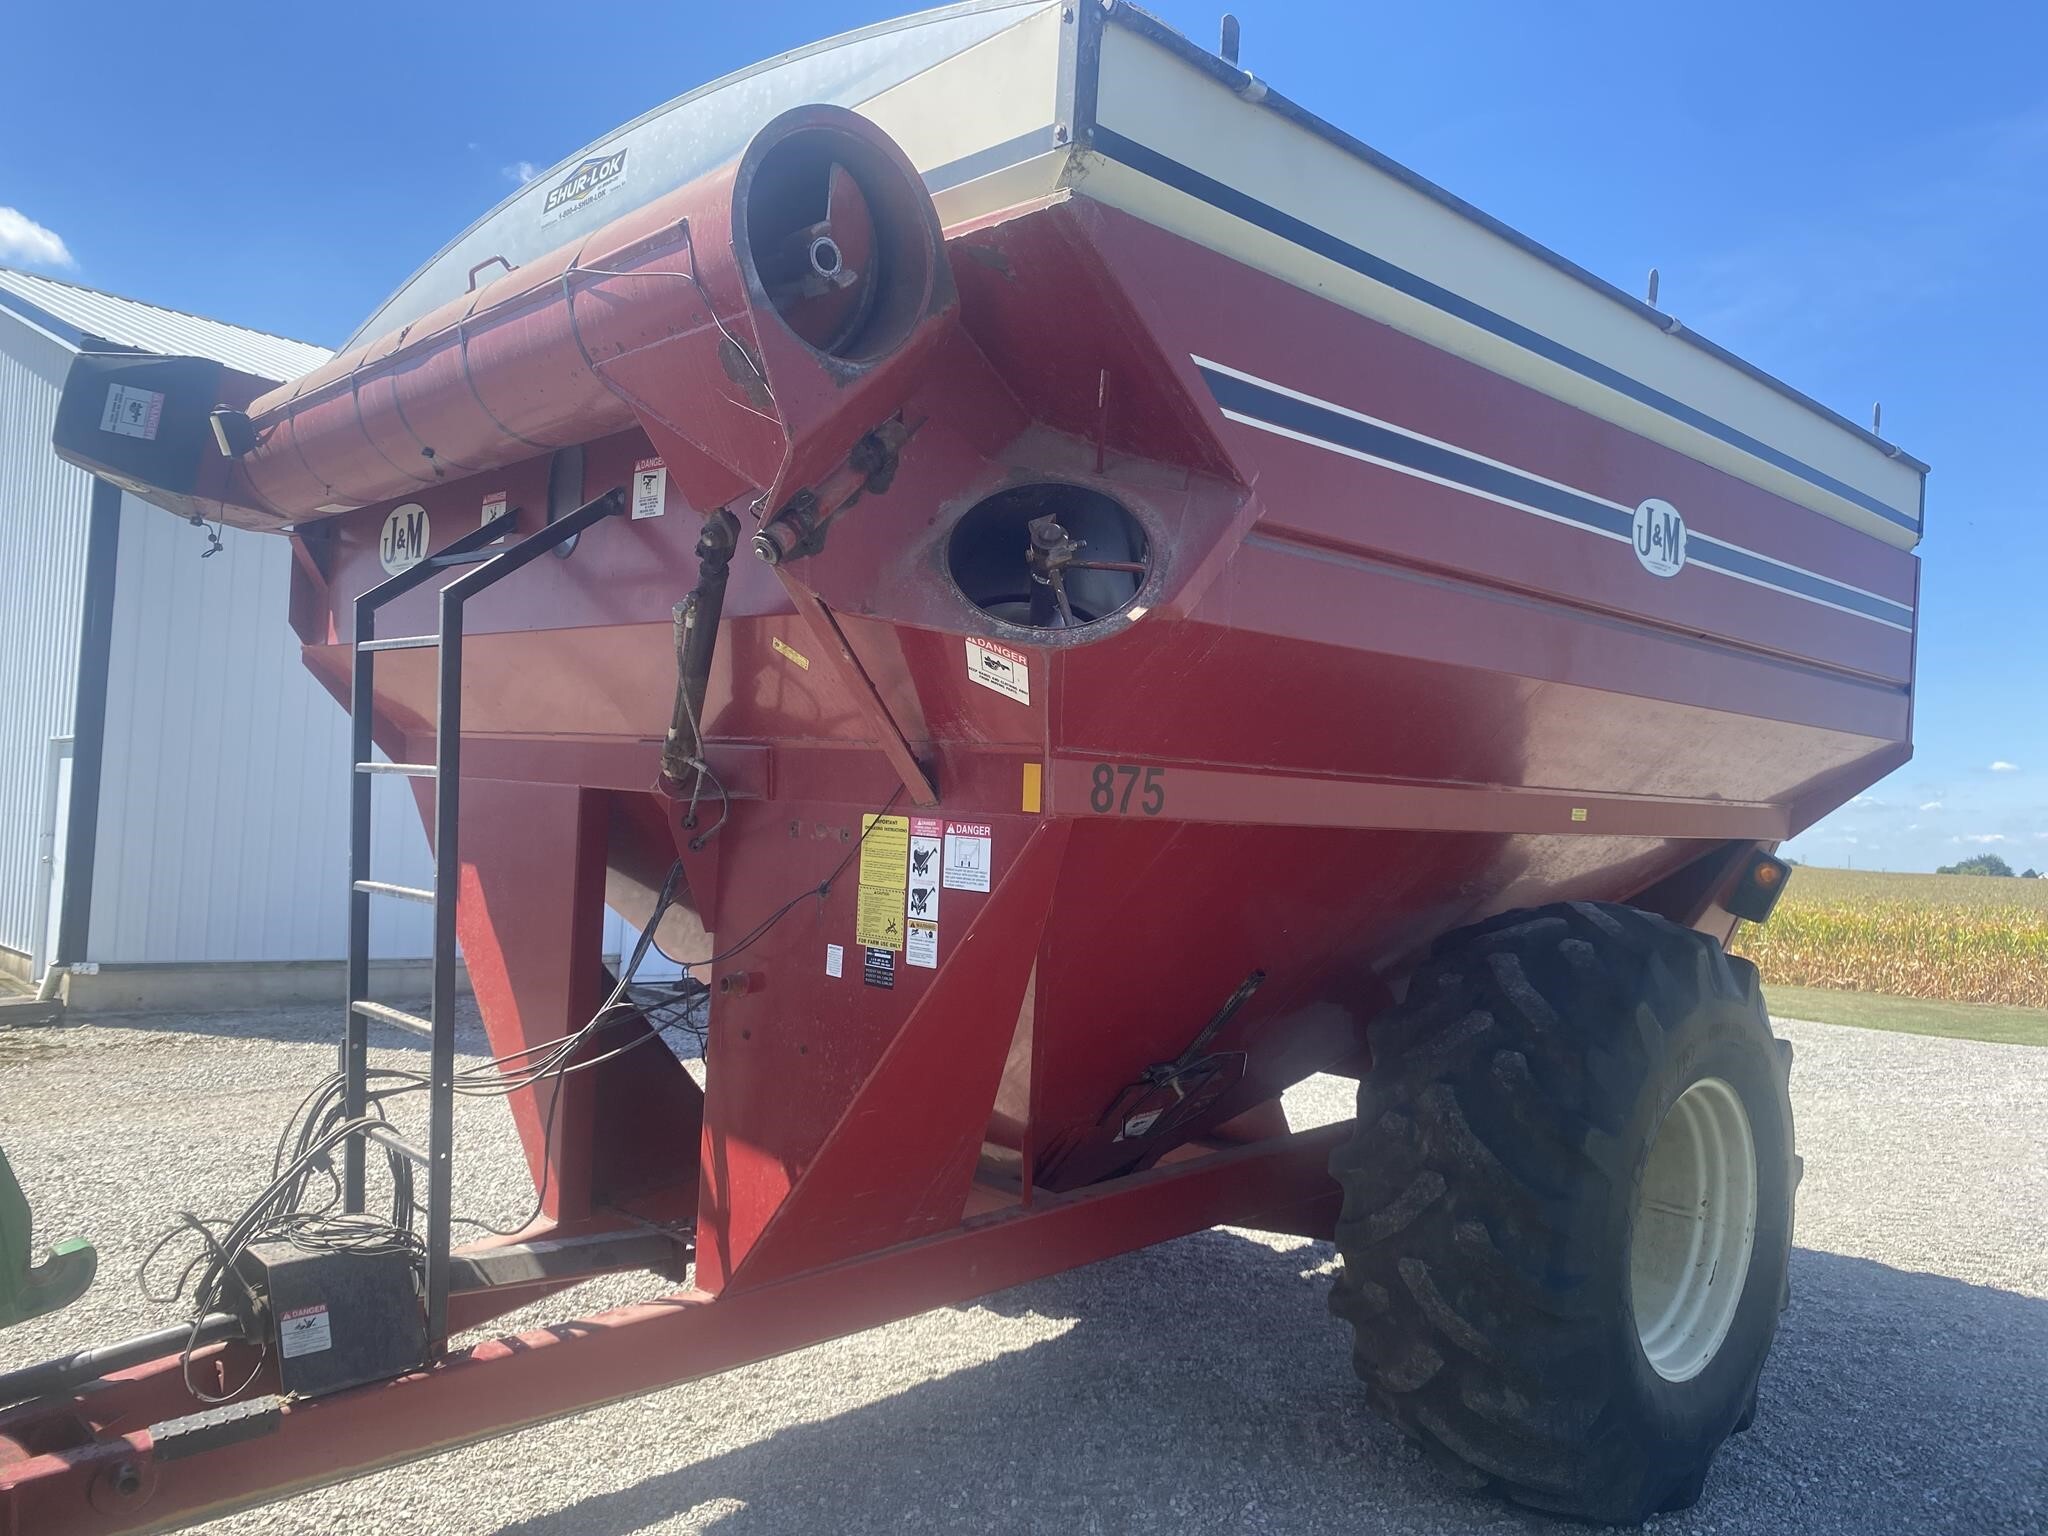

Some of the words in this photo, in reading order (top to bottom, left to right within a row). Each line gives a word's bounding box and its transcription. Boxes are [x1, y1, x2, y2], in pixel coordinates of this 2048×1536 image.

[546, 154, 623, 210] SHUR-LOK
[383, 511, 425, 564] J&M
[1637, 506, 1681, 566] J&M
[977, 638, 1027, 665] DANGER
[1090, 763, 1165, 816] 875
[956, 824, 991, 836] DANGER
[292, 1305, 326, 1317] DANGER
